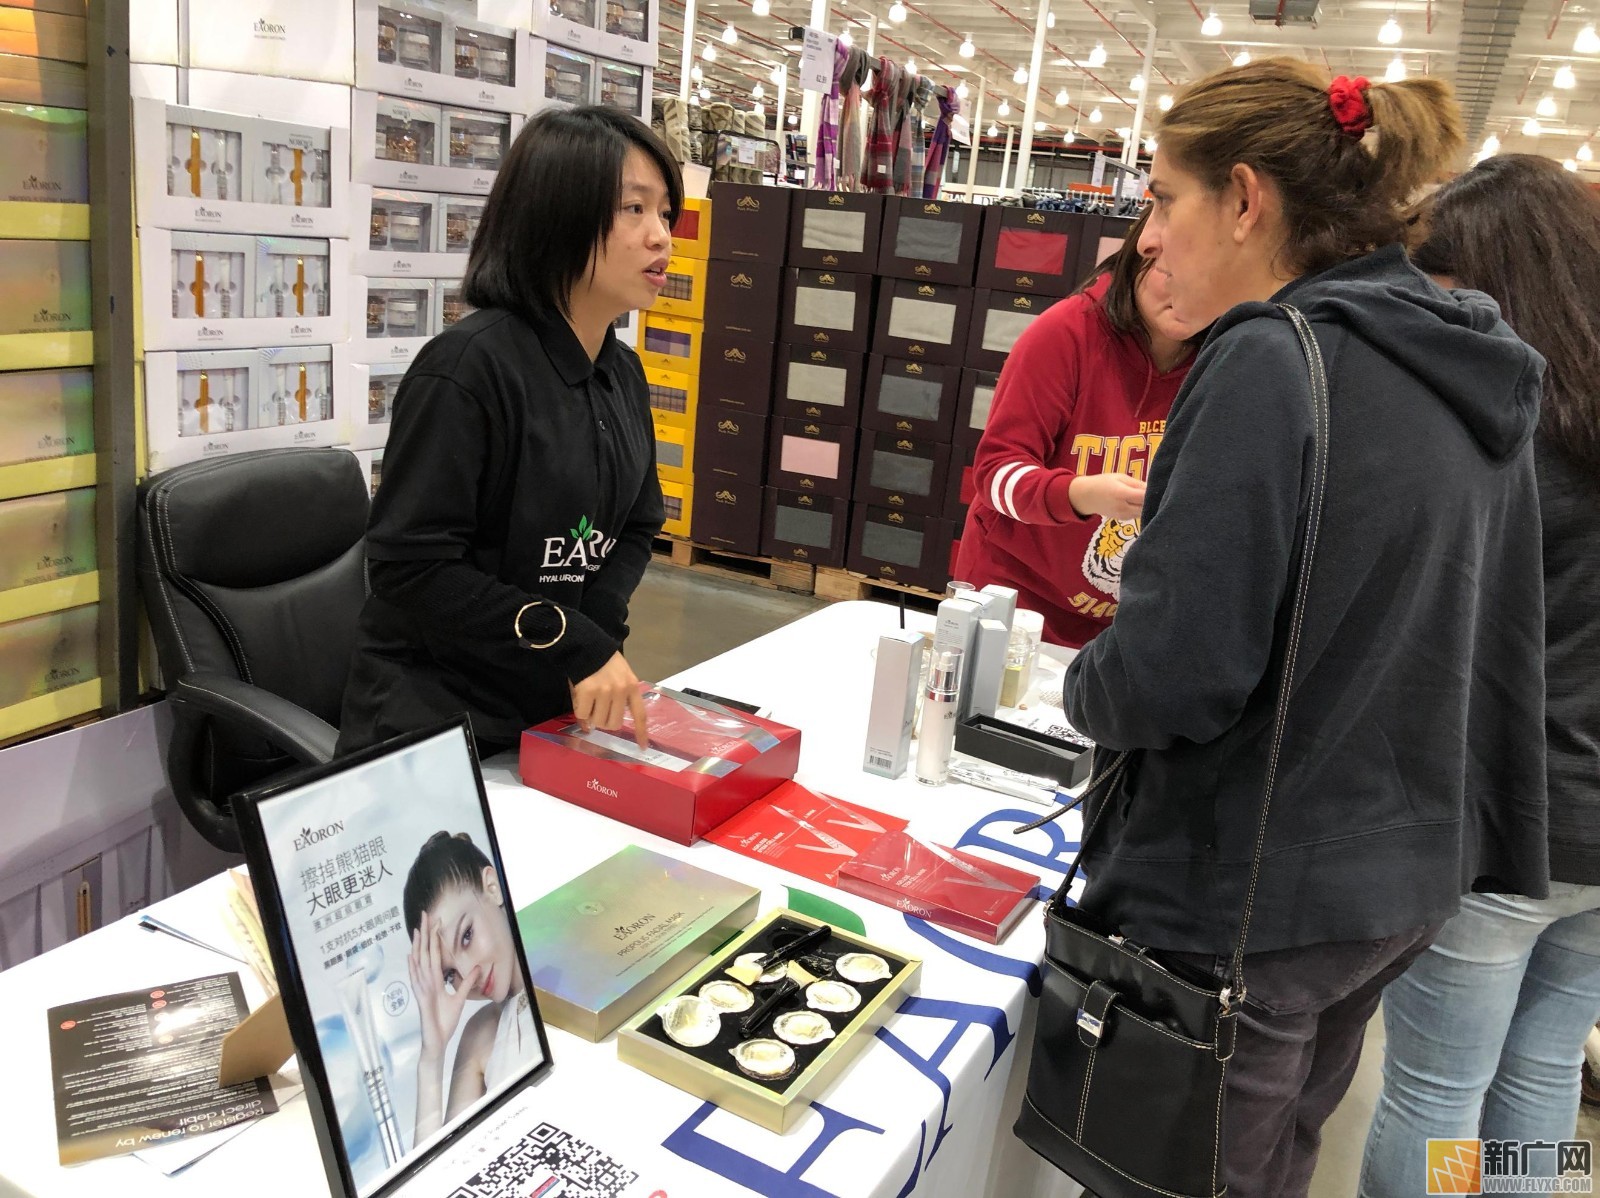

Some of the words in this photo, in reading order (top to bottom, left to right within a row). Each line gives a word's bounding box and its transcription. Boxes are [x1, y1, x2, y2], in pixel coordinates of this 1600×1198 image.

[586, 779, 618, 798] EAORON
[293, 820, 345, 851] EAORON
[300, 835, 388, 893] 擦掉熊猫眼
[306, 859, 393, 917] 大眼更迷人
[896, 898, 933, 918] EAORON
[613, 913, 656, 941] EAORON
[617, 935, 649, 957] PROPOLIS
[646, 922, 667, 938] FACIAL
[664, 911, 685, 925] MASK
[178, 1110, 217, 1127] debit
[208, 1107, 265, 1129] Register
[221, 1100, 262, 1118] direct
[139, 1127, 186, 1143] renew
[189, 1122, 204, 1133] to
[115, 1136, 136, 1148] by
